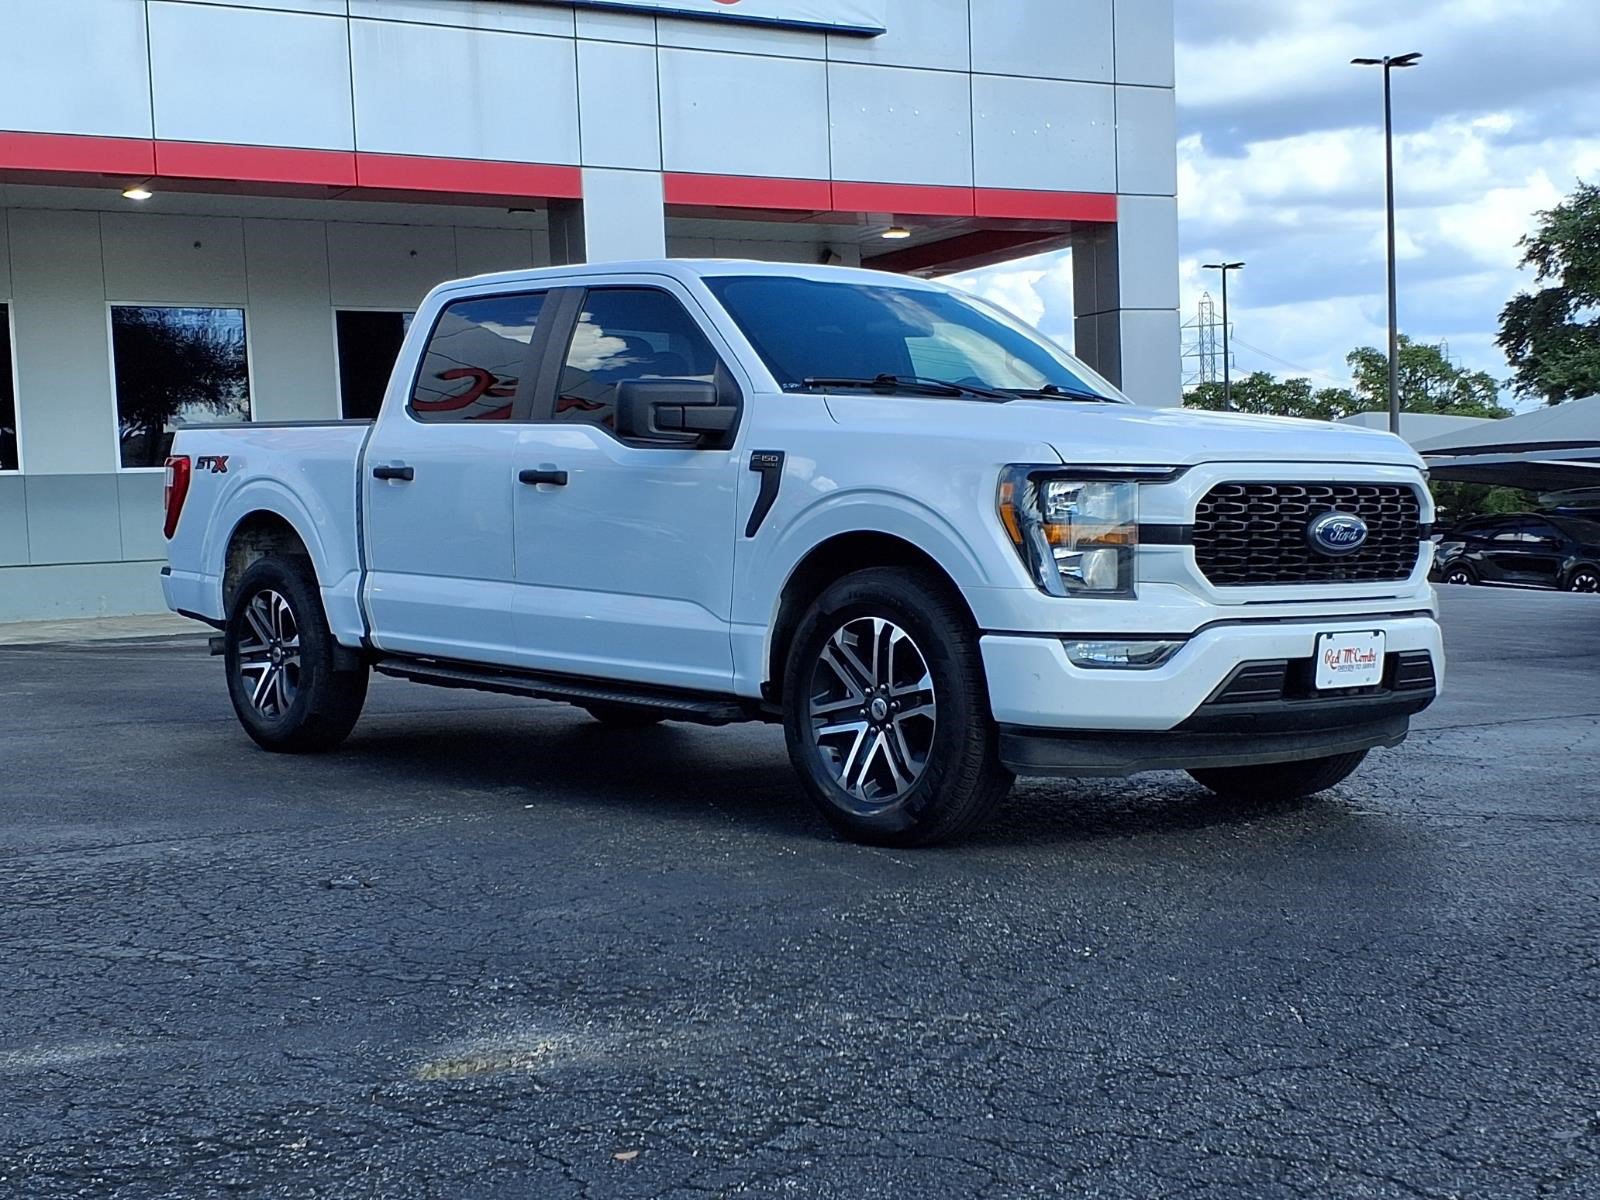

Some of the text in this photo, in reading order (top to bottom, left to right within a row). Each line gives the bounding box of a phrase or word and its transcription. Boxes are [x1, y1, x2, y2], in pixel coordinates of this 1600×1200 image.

[195, 456, 229, 473] STX
[1330, 522, 1358, 542] Ford
[1324, 648, 1341, 670] Red
